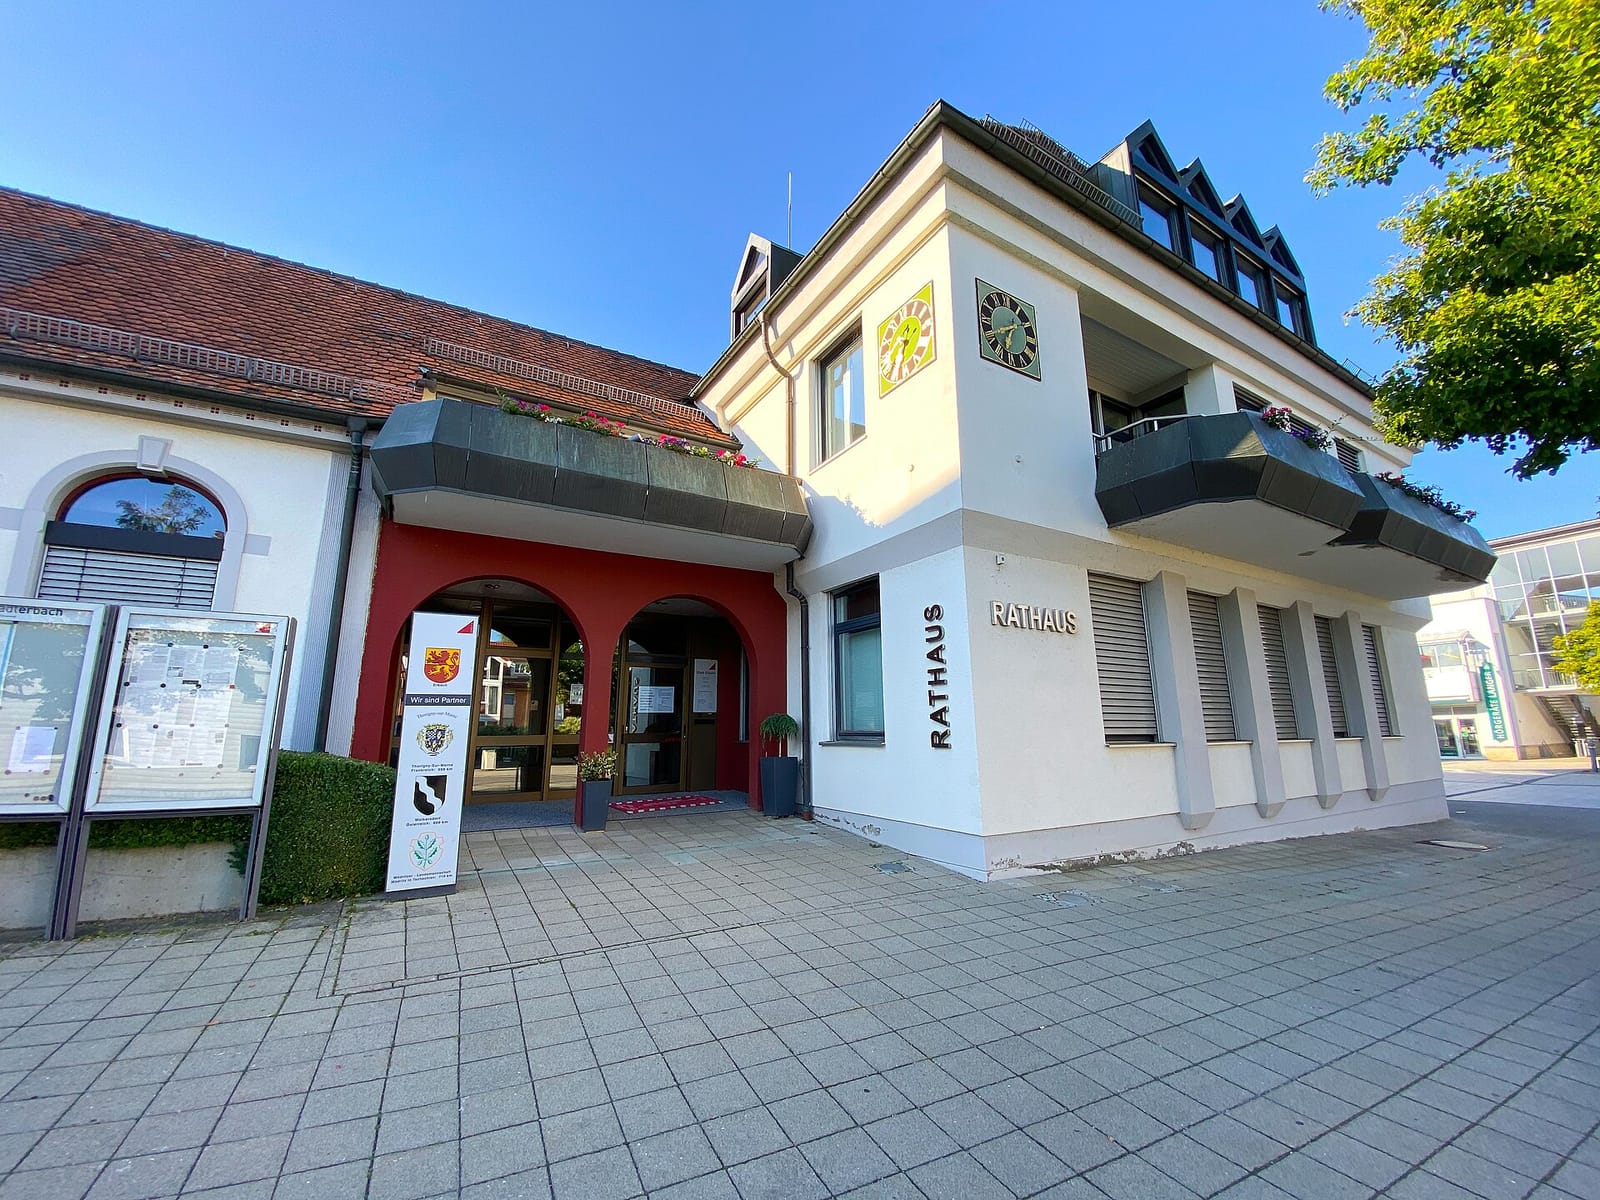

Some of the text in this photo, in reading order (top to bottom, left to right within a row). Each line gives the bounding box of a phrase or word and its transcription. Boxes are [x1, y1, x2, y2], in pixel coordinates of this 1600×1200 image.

[991, 600, 1077, 634] RATHAUS
[923, 604, 951, 749] RATHAUS
[1484, 671, 1497, 698] LANGER
[410, 696, 467, 704] Wir sind Partner
